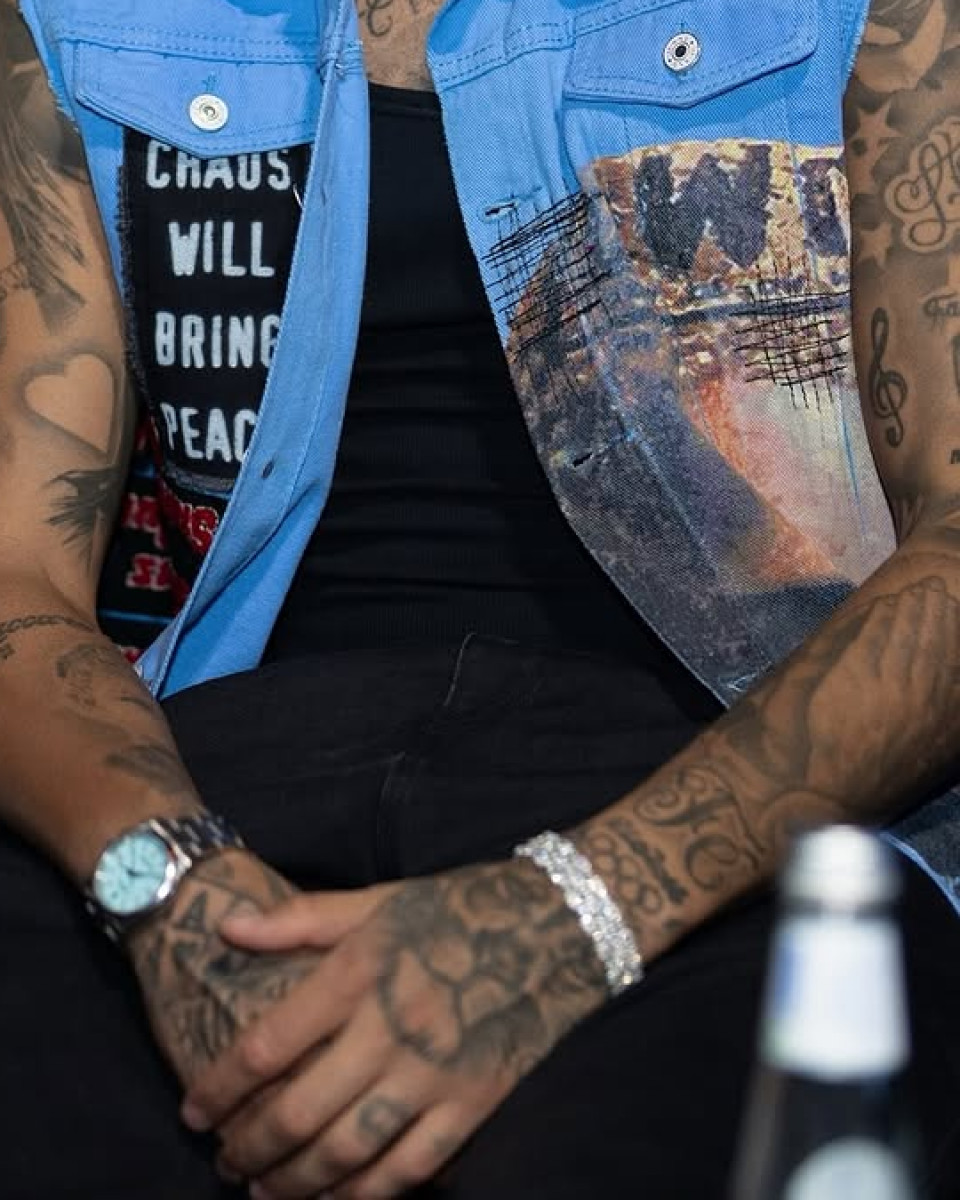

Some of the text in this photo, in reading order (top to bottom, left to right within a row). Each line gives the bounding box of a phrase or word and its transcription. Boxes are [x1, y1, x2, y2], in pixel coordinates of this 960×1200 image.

[146, 139, 291, 191] CHAOS
[168, 219, 276, 277] WILL
[155, 311, 280, 369] BRING
[160, 402, 257, 463] PEAC
